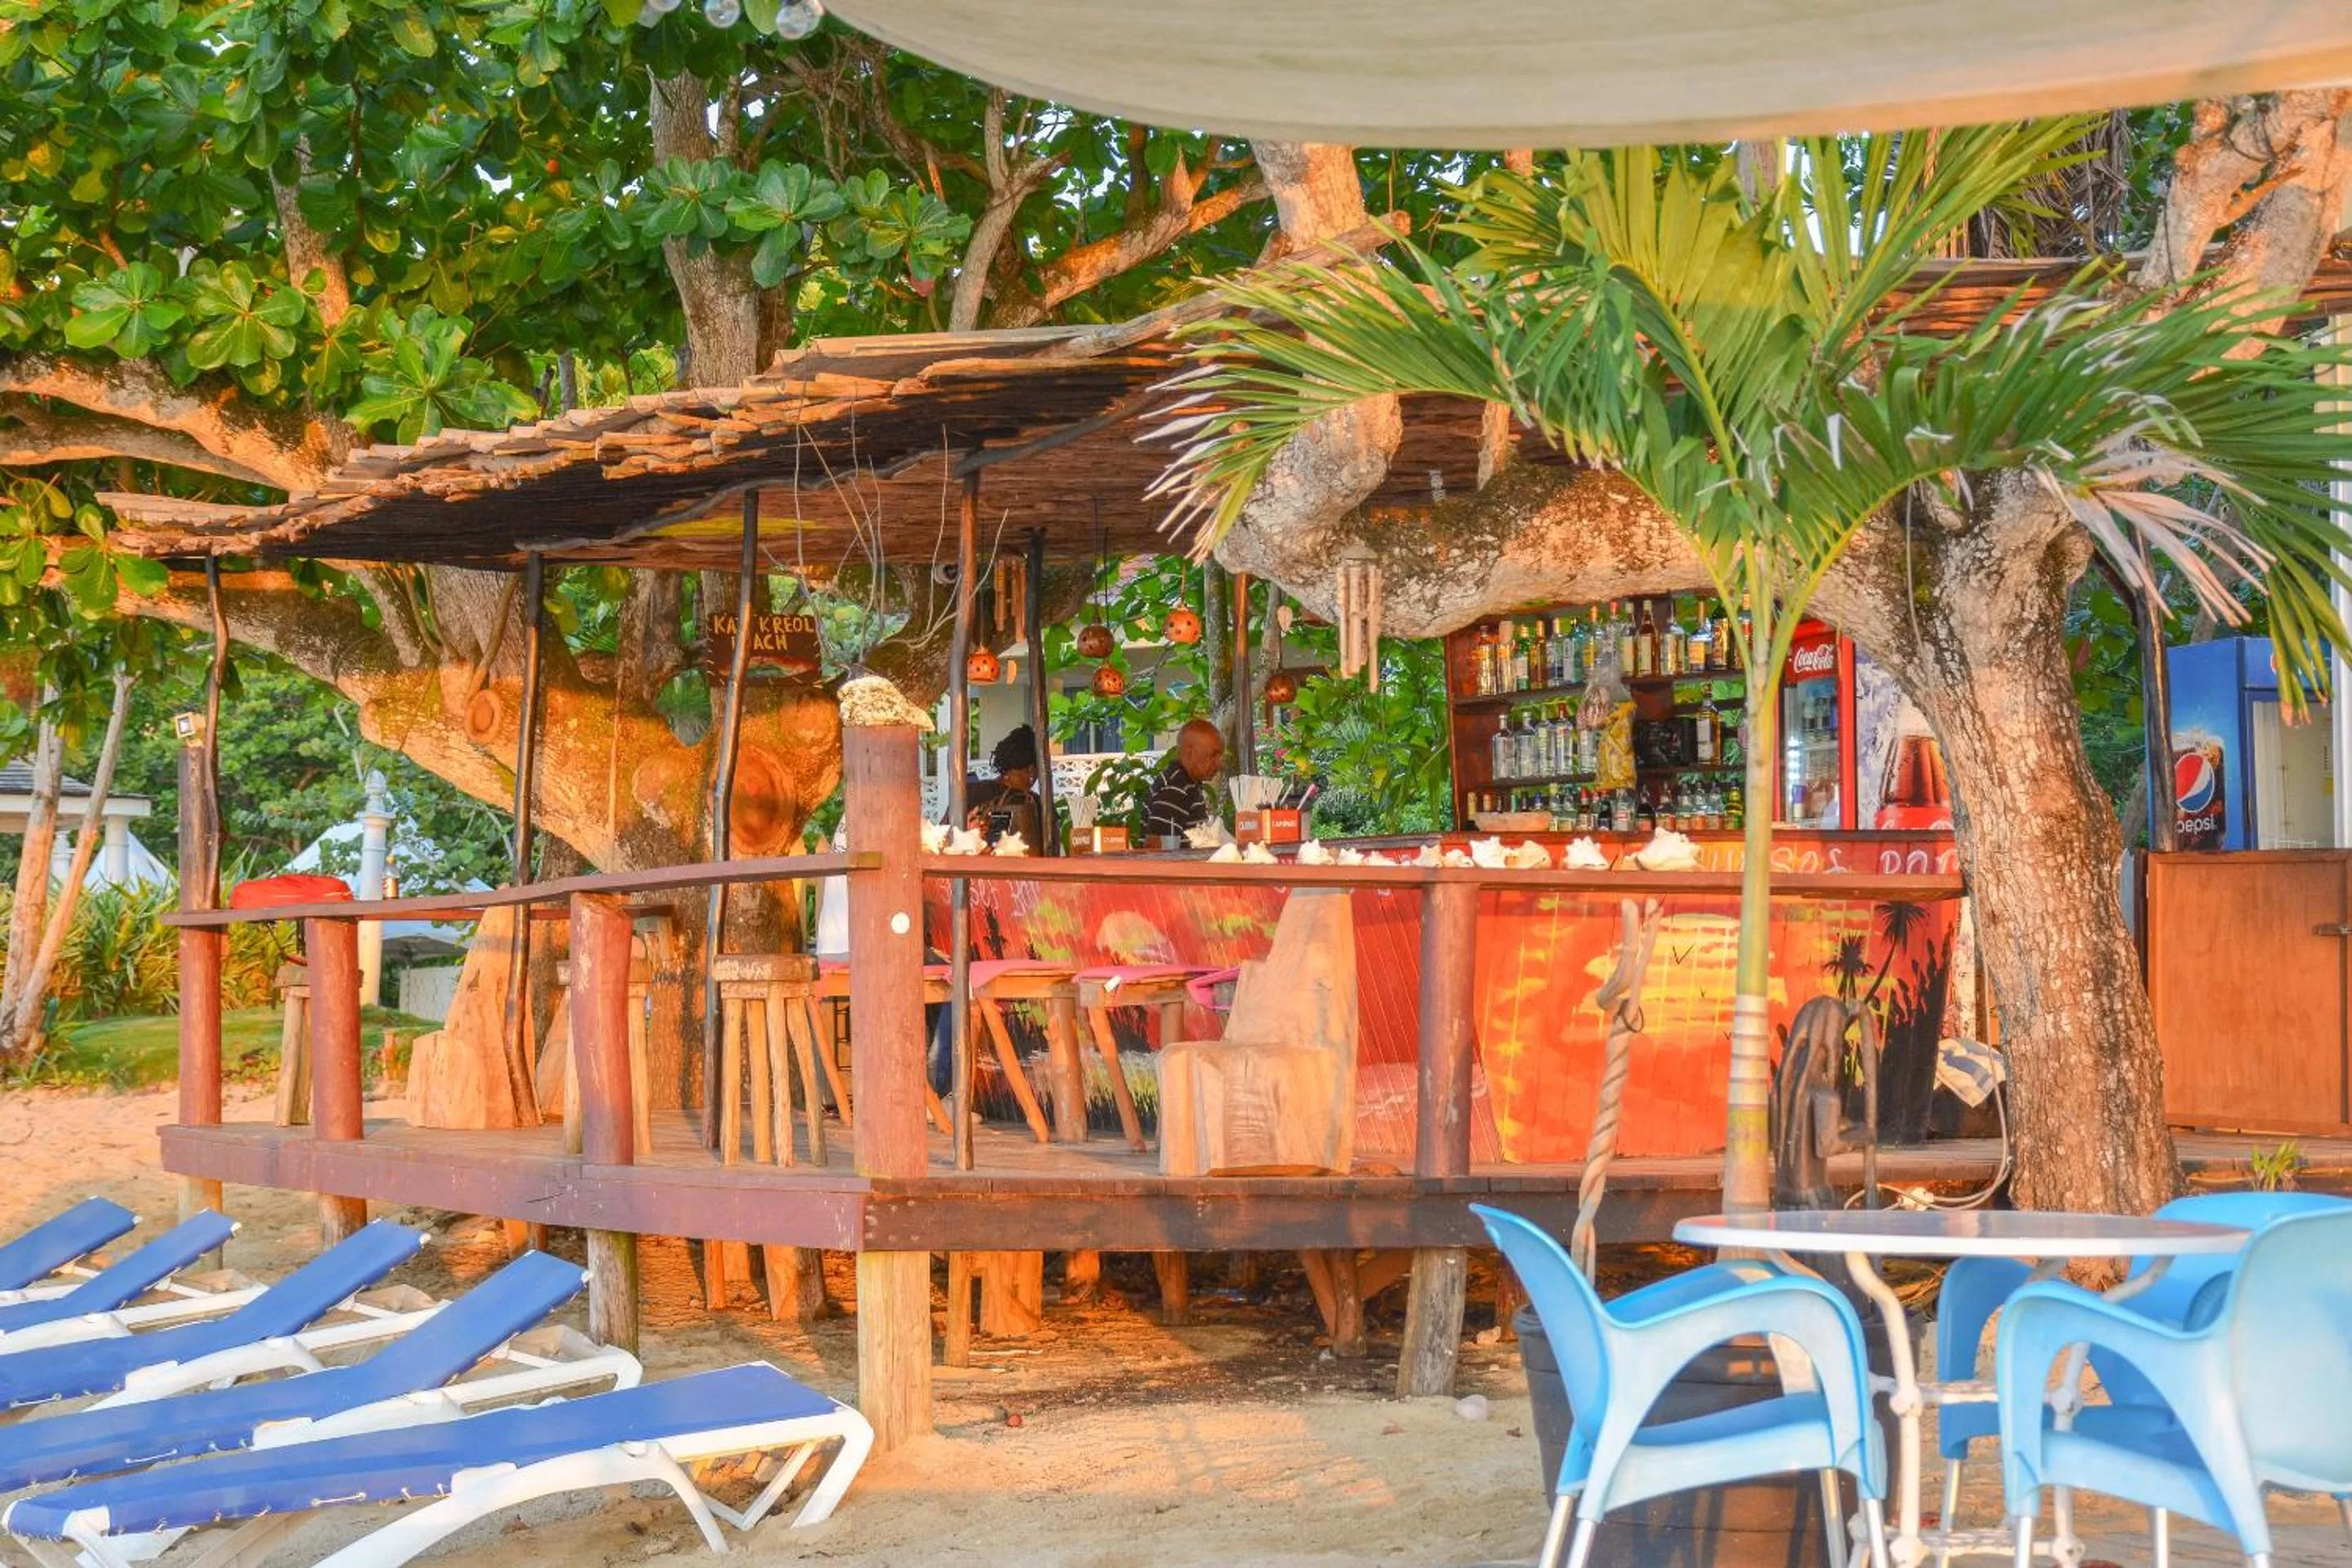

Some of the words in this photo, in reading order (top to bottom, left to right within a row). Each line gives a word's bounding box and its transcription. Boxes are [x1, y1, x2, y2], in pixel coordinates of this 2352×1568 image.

[714, 615, 740, 634] KA
[759, 616, 814, 634] KREOL
[731, 634, 788, 650] ACH
